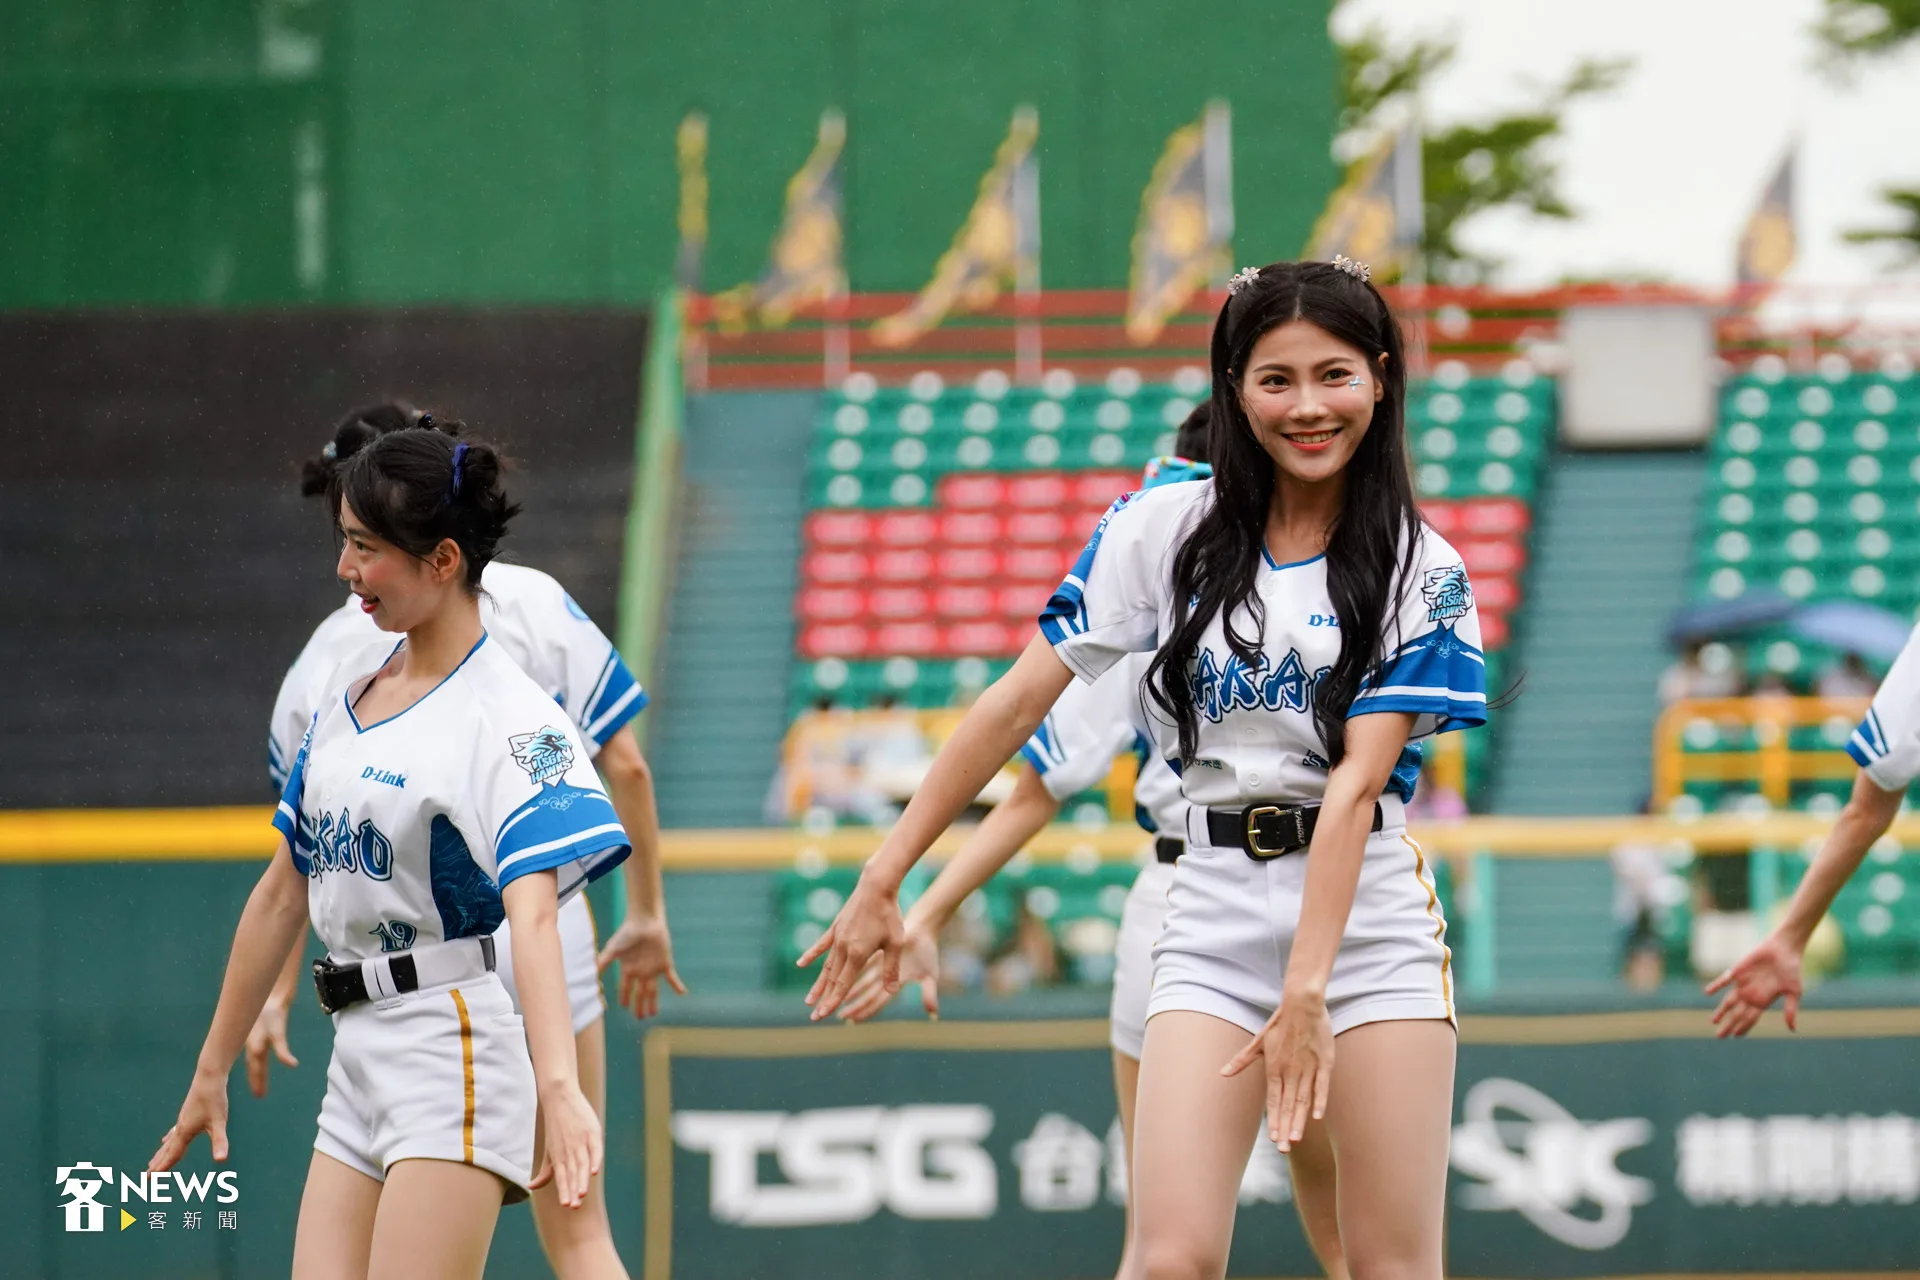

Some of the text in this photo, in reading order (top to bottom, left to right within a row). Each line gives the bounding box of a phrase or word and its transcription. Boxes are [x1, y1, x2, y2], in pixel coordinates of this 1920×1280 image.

[1428, 604, 1467, 622] HAWKS
[1184, 646, 1334, 723] AKA
[361, 765, 408, 789] D-Link
[530, 760, 572, 785] HAWKS
[368, 919, 417, 952] 19
[672, 1103, 999, 1227] TSG
